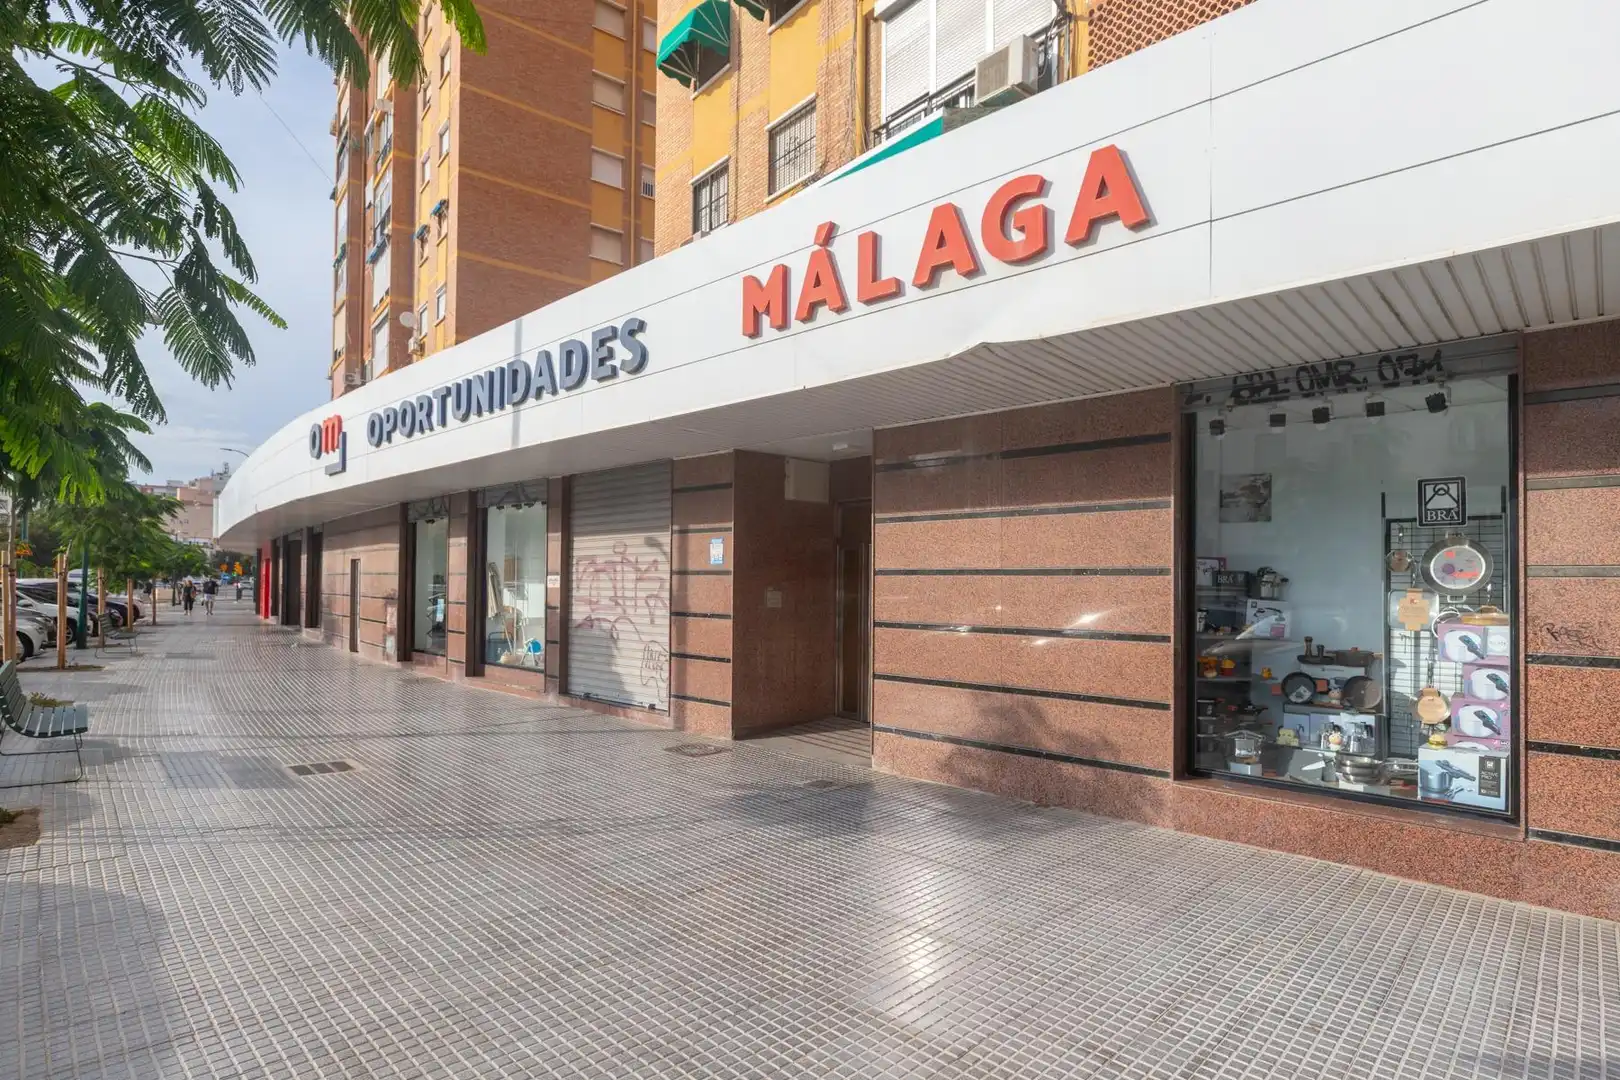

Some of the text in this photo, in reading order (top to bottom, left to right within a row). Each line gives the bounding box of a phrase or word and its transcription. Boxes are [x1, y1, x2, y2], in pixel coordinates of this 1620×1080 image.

[366, 317, 649, 447] OPORTUNIDADES
[742, 144, 1150, 338] MÁLAGA
[1427, 509, 1458, 521] BRA
